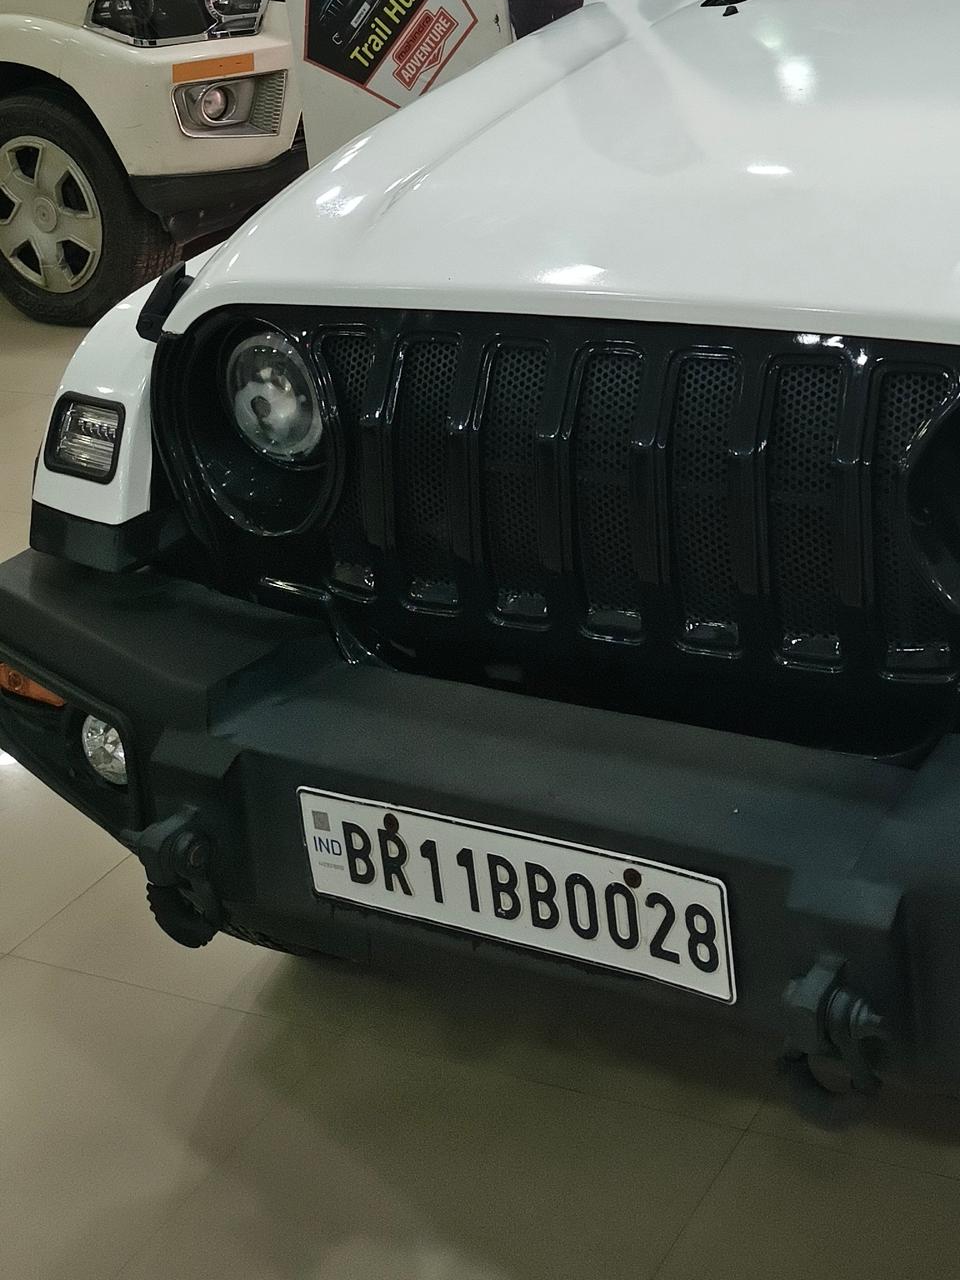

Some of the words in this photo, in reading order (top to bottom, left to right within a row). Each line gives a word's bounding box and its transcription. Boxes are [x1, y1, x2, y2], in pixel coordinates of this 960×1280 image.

[349, 17, 392, 68] Trail
[401, 15, 451, 82] ADVENTURE
[313, 835, 342, 856] IND
[341, 820, 720, 974] BR11BB0028
